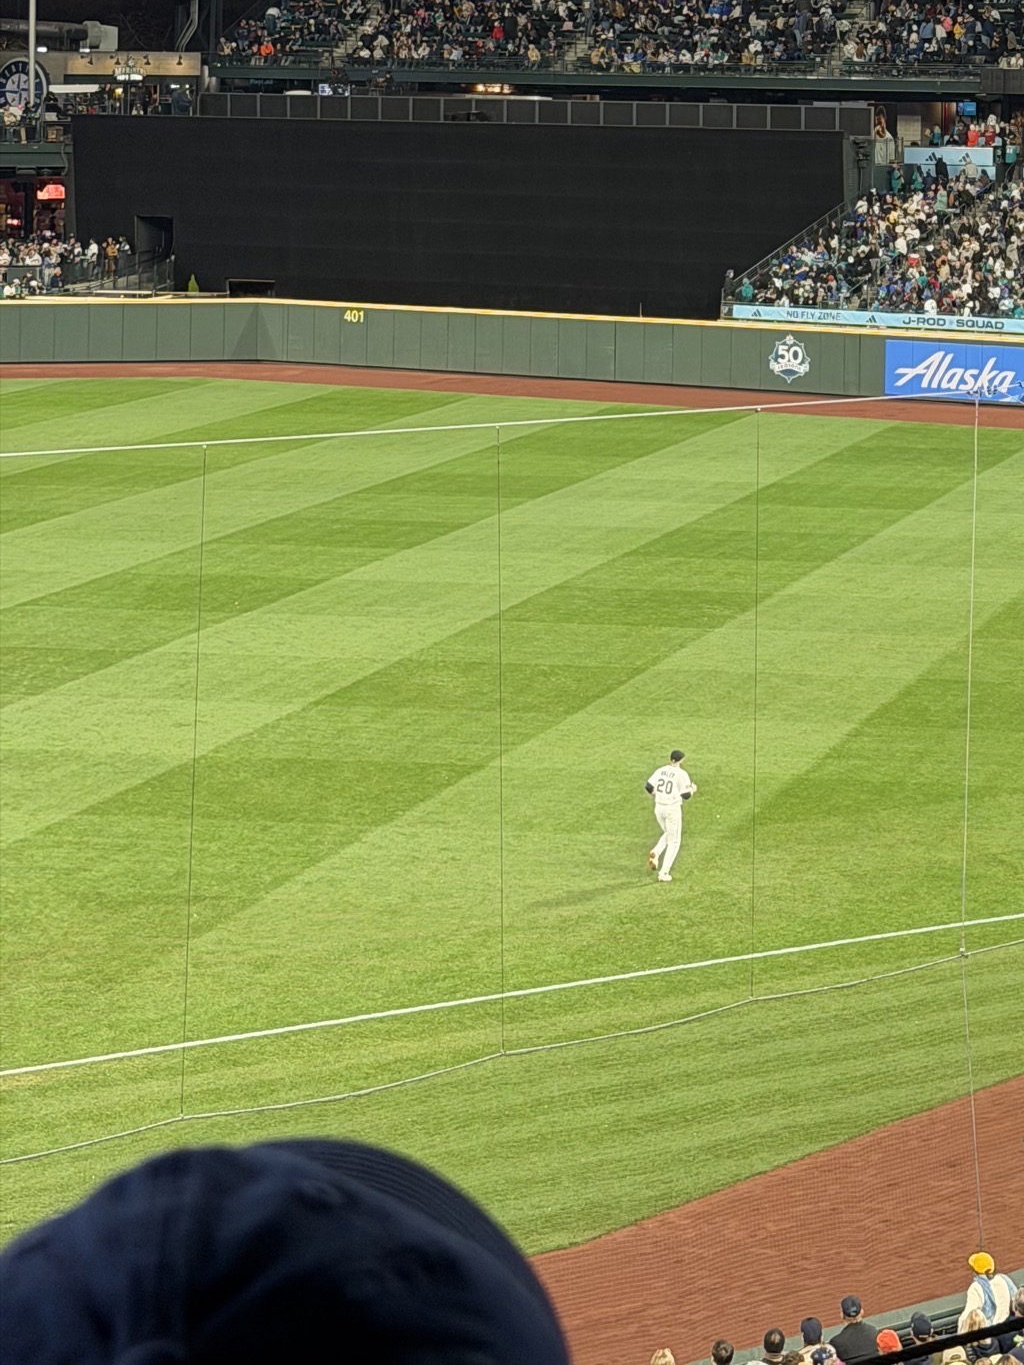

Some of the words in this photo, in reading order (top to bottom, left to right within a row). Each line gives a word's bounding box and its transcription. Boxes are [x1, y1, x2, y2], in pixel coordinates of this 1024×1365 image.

[343, 309, 364, 323] 401
[786, 310, 799, 319] NO
[801, 311, 816, 320] FLY
[818, 312, 842, 321] ZONE
[902, 317, 946, 327] J-ROD
[955, 319, 1005, 330] SQUAD
[777, 345, 803, 364] 50
[894, 350, 1016, 397] Alaska
[656, 778, 673, 795] 20
